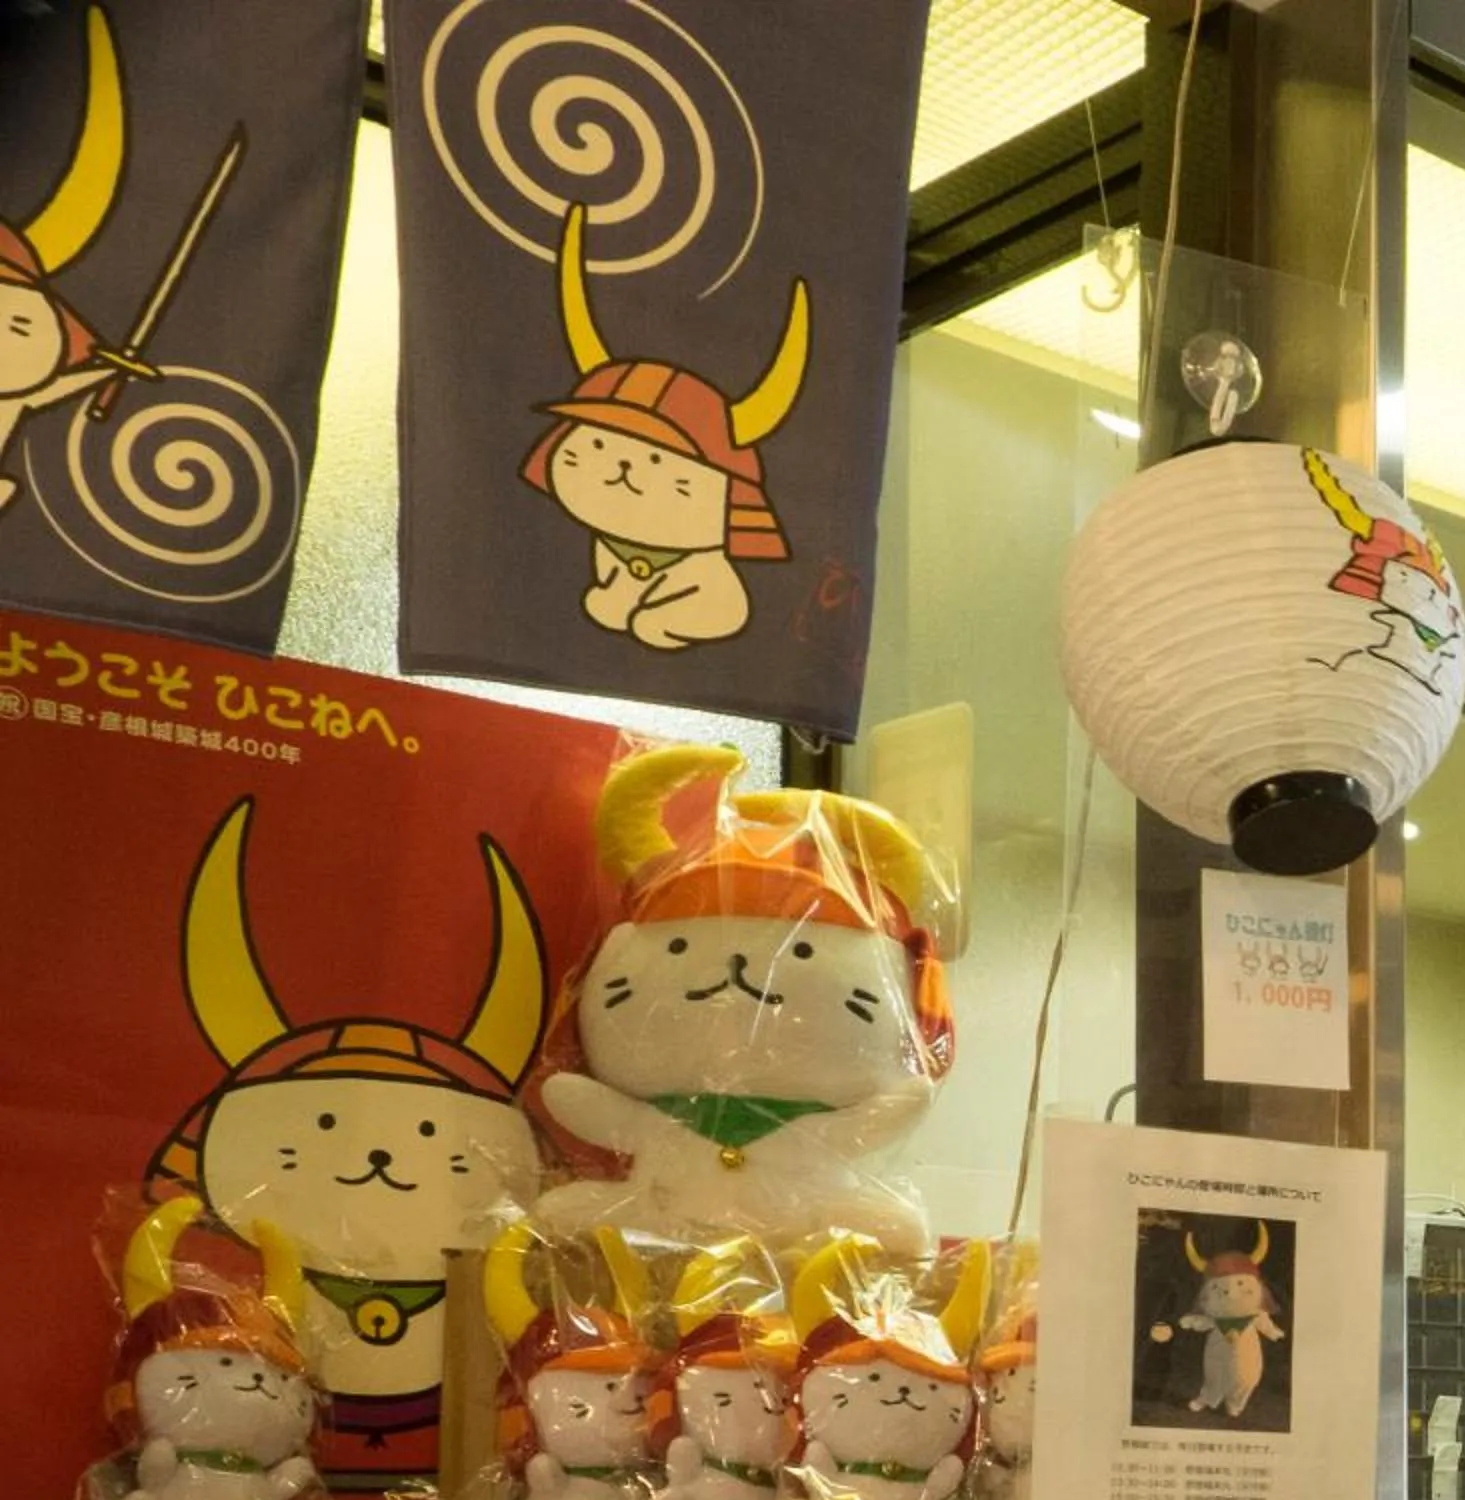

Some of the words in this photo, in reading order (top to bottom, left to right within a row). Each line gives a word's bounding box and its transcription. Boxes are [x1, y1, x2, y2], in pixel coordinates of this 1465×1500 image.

[0, 632, 193, 710] ようこそ
[215, 676, 419, 753] ひこねへ。
